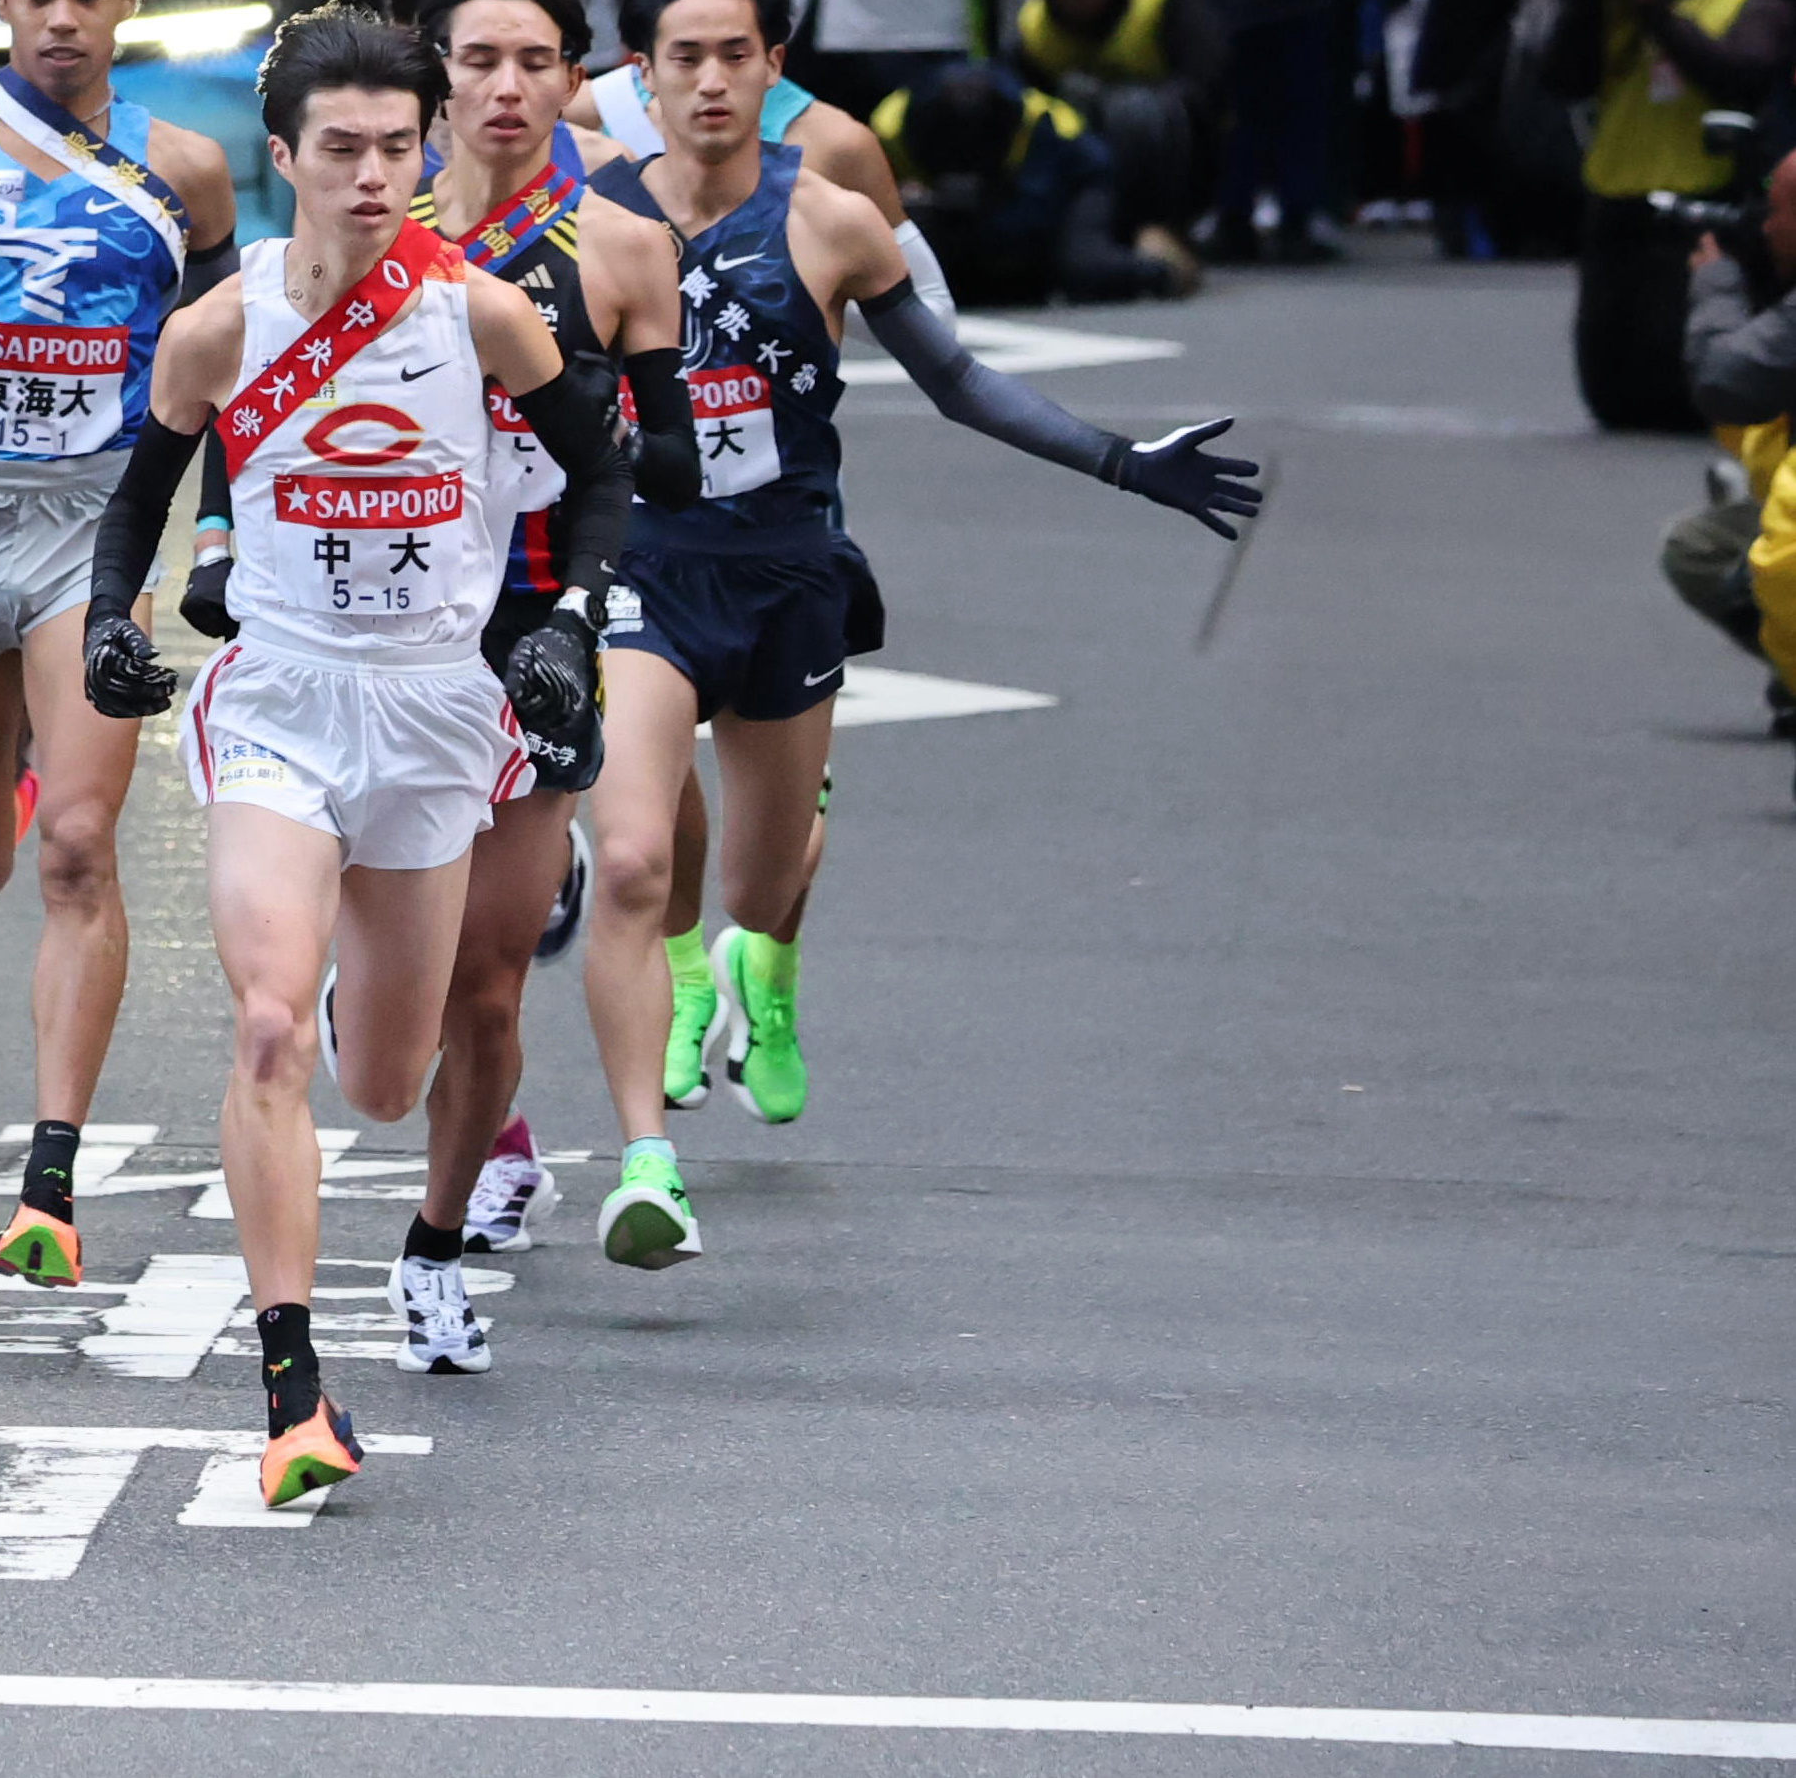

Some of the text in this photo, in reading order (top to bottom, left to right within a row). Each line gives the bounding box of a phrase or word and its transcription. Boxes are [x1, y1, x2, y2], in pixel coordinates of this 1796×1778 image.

[677, 264, 819, 396] 東洋大学
[231, 298, 377, 440] 中央大学
[688, 375, 763, 411] PORO
[315, 483, 459, 520] SAPPORO
[331, 578, 411, 610] 5-15
[525, 730, 578, 767] 価大学
